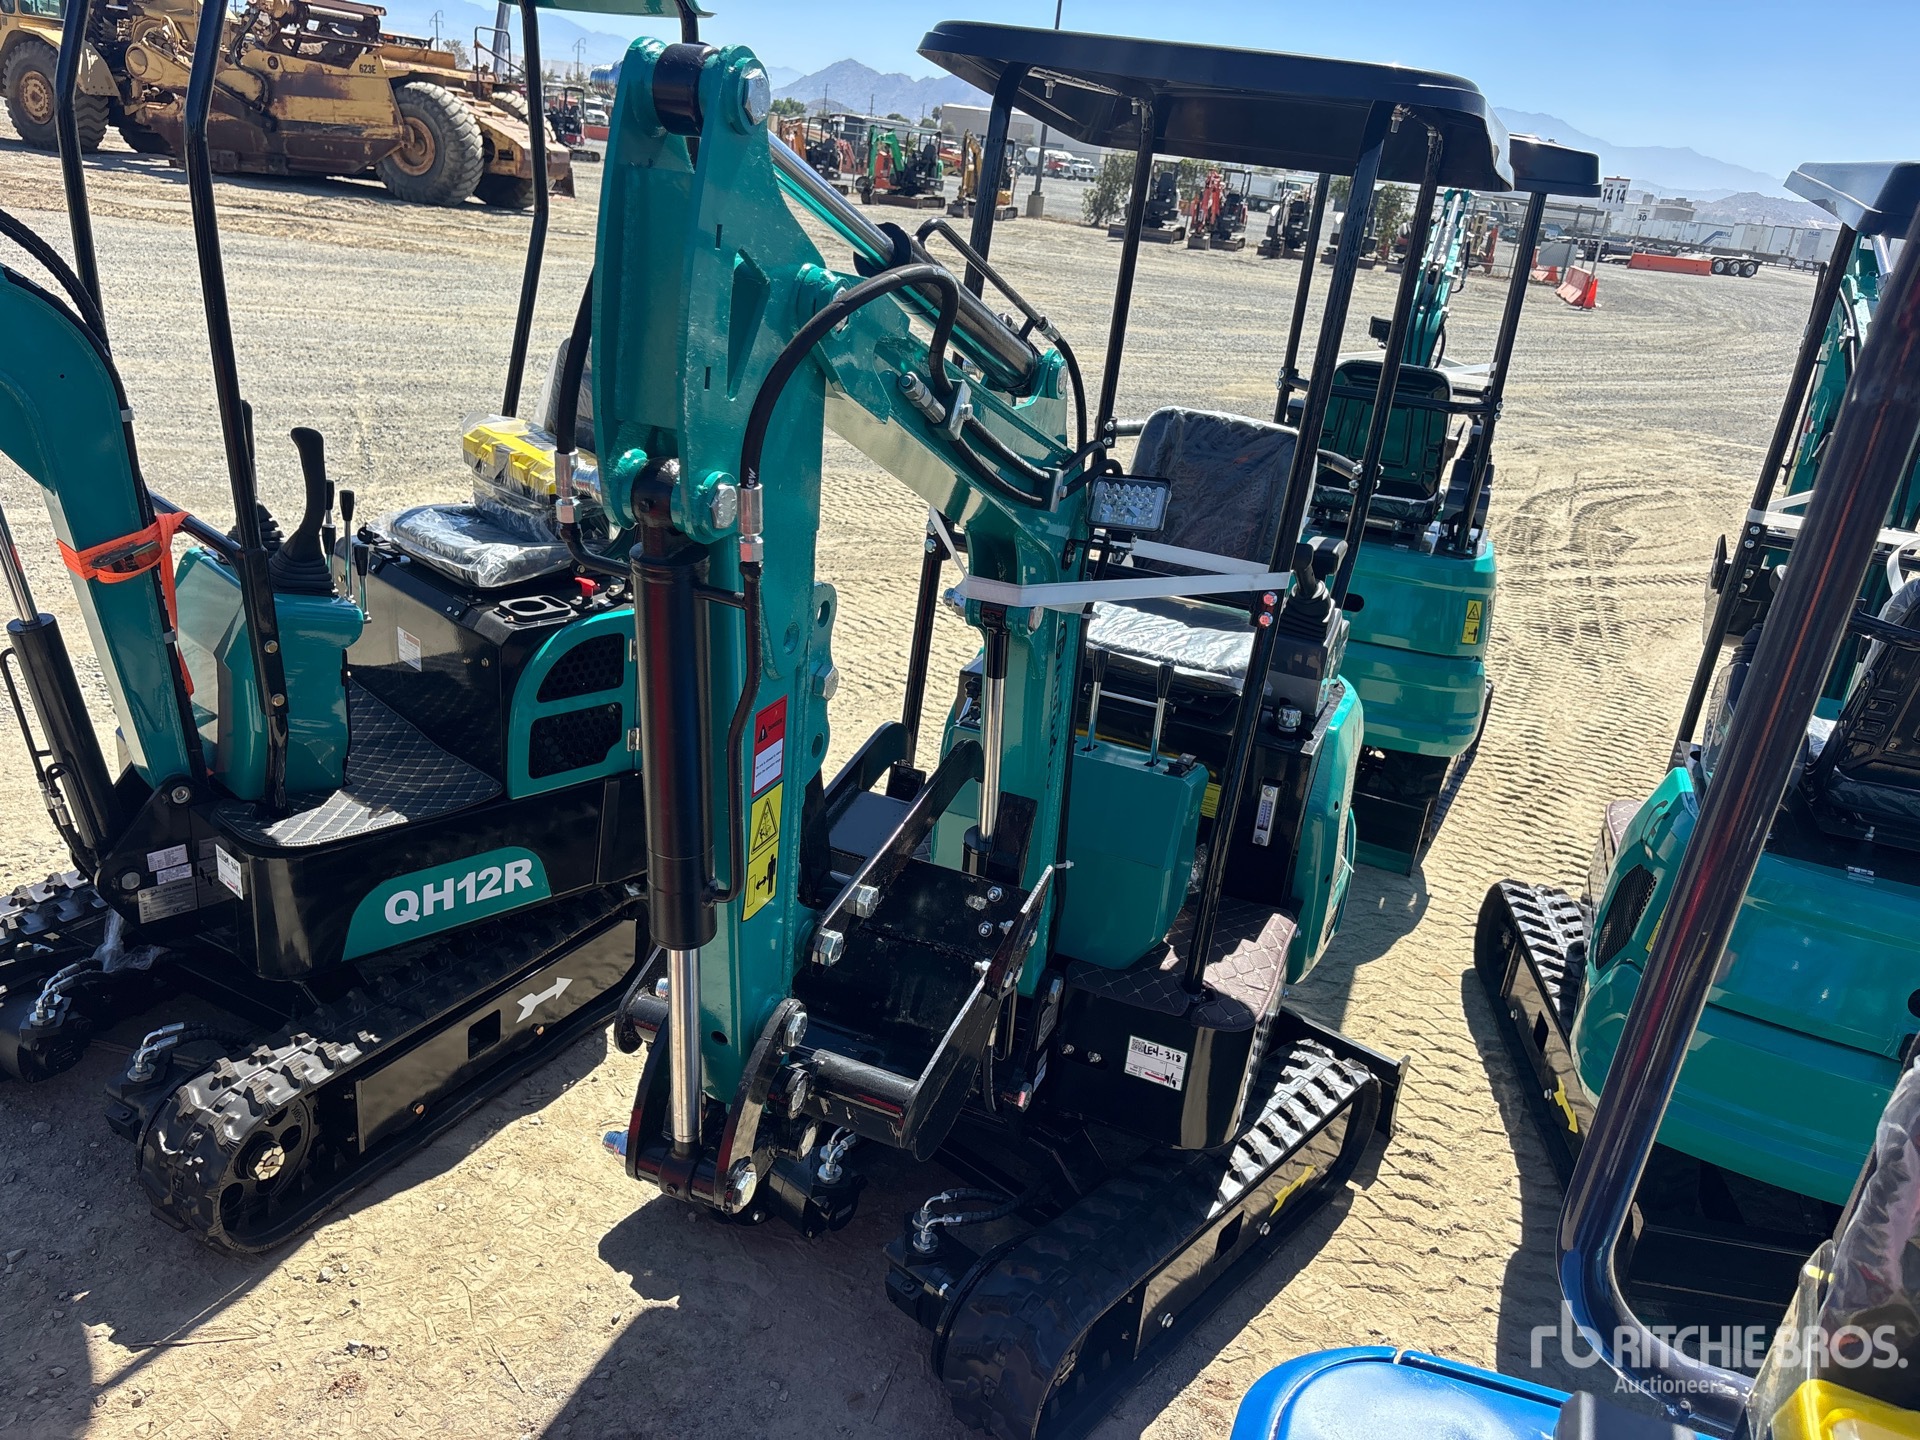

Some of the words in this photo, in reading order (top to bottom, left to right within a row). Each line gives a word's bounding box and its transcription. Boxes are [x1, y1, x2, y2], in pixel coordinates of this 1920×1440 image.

[359, 64, 377, 74] 623E
[1602, 188, 1613, 203] 14
[1615, 189, 1626, 203] 14
[384, 859, 534, 925] QH12R
[1143, 1044, 1182, 1063] LE4-318
